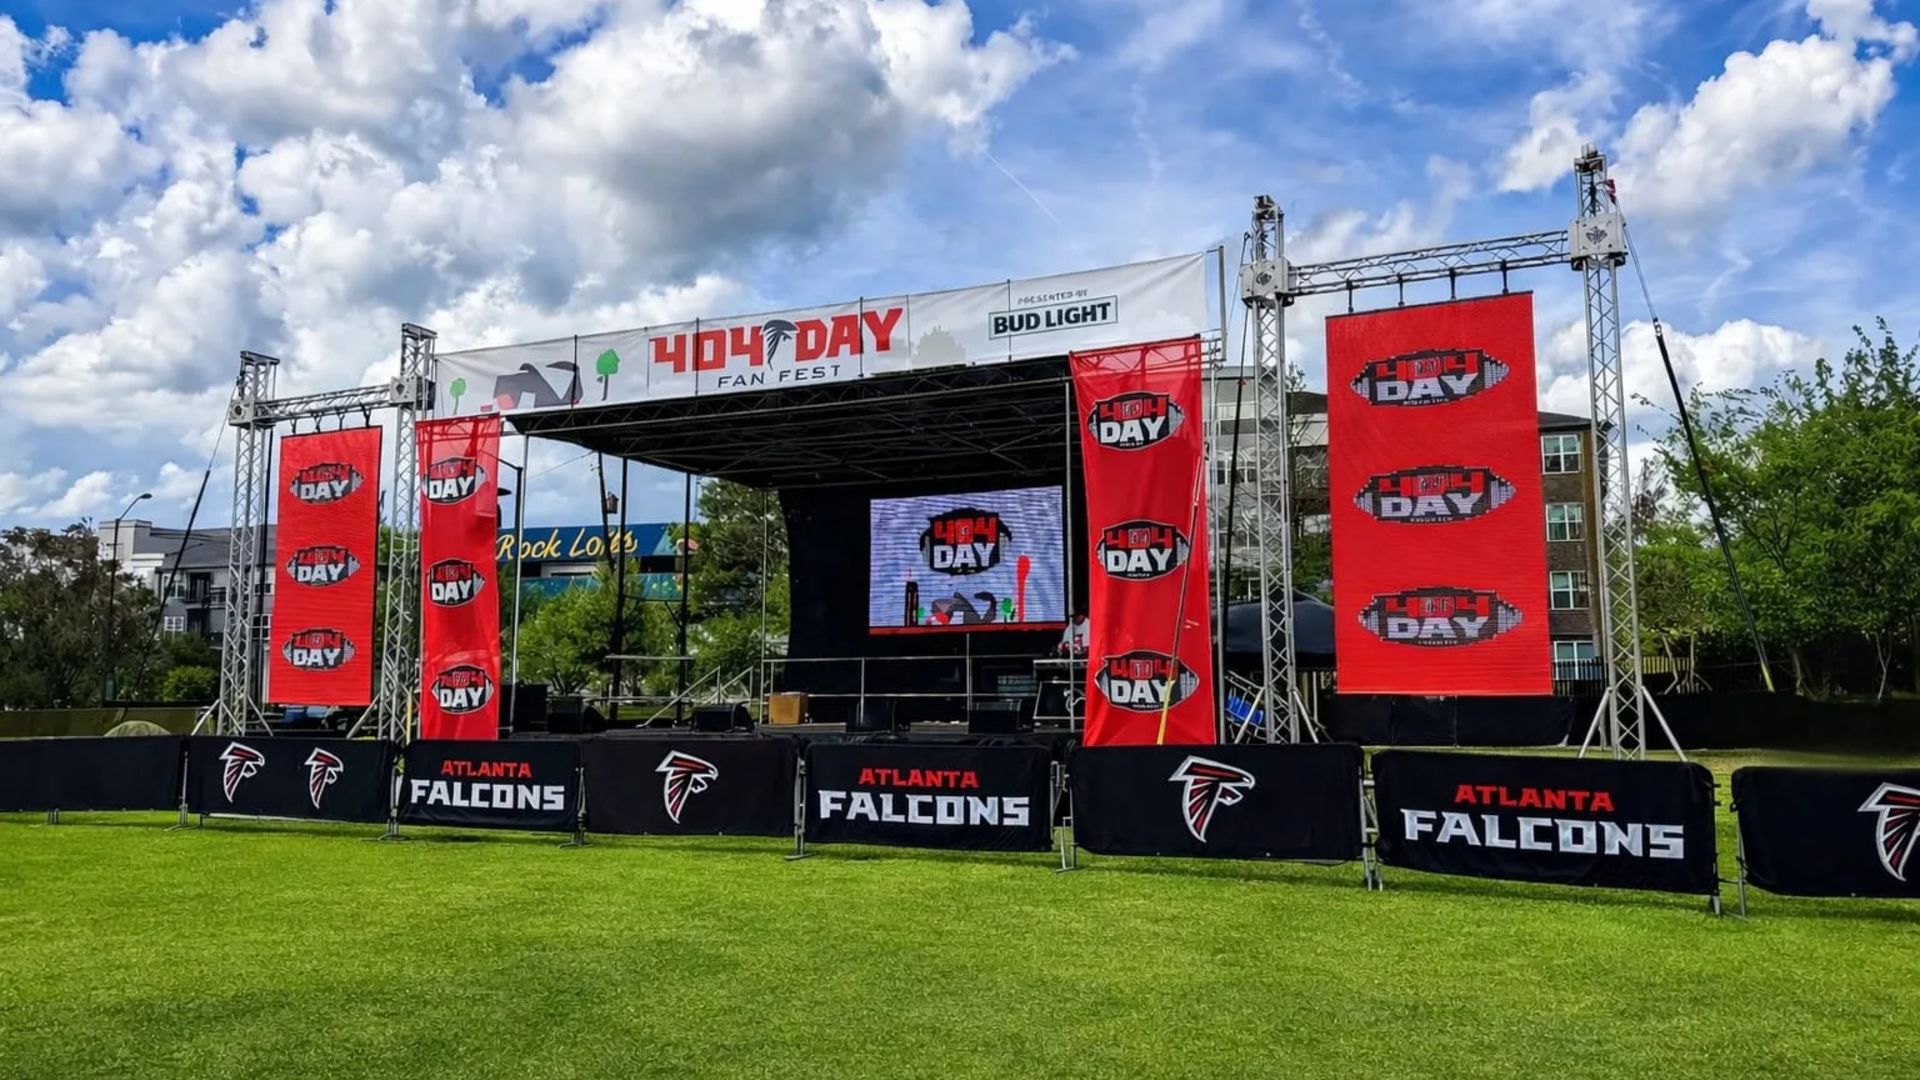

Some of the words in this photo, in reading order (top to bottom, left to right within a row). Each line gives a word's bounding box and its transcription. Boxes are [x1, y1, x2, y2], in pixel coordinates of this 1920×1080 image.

[994, 312, 1041, 335] BUD
[1045, 302, 1111, 329] LIGHT
[649, 325, 764, 374] 404
[794, 307, 904, 363] DAY
[717, 371, 765, 389] FAN
[779, 364, 841, 383] FEST
[1376, 373, 1480, 402] DAY
[1100, 416, 1166, 444] DAY
[300, 479, 349, 500] DAY
[429, 475, 475, 499] DAY
[1380, 492, 1485, 517] DAY
[933, 516, 997, 545] 404
[495, 528, 562, 561] Rock
[933, 542, 996, 569] DAY
[297, 563, 346, 583] DAY
[1107, 548, 1173, 573] DAY
[431, 580, 473, 603] DAY
[1386, 616, 1489, 639] DAY
[293, 647, 341, 667] DAY
[440, 686, 484, 708] DAY
[1110, 679, 1176, 704] DAY
[441, 759, 533, 778] ATLANTA
[858, 767, 980, 789] ATLANTA
[410, 778, 565, 811] FALCONS
[1454, 784, 1616, 812] ATLANTA
[818, 789, 1031, 827] FALCONS
[1400, 808, 1685, 860] FALCONS
